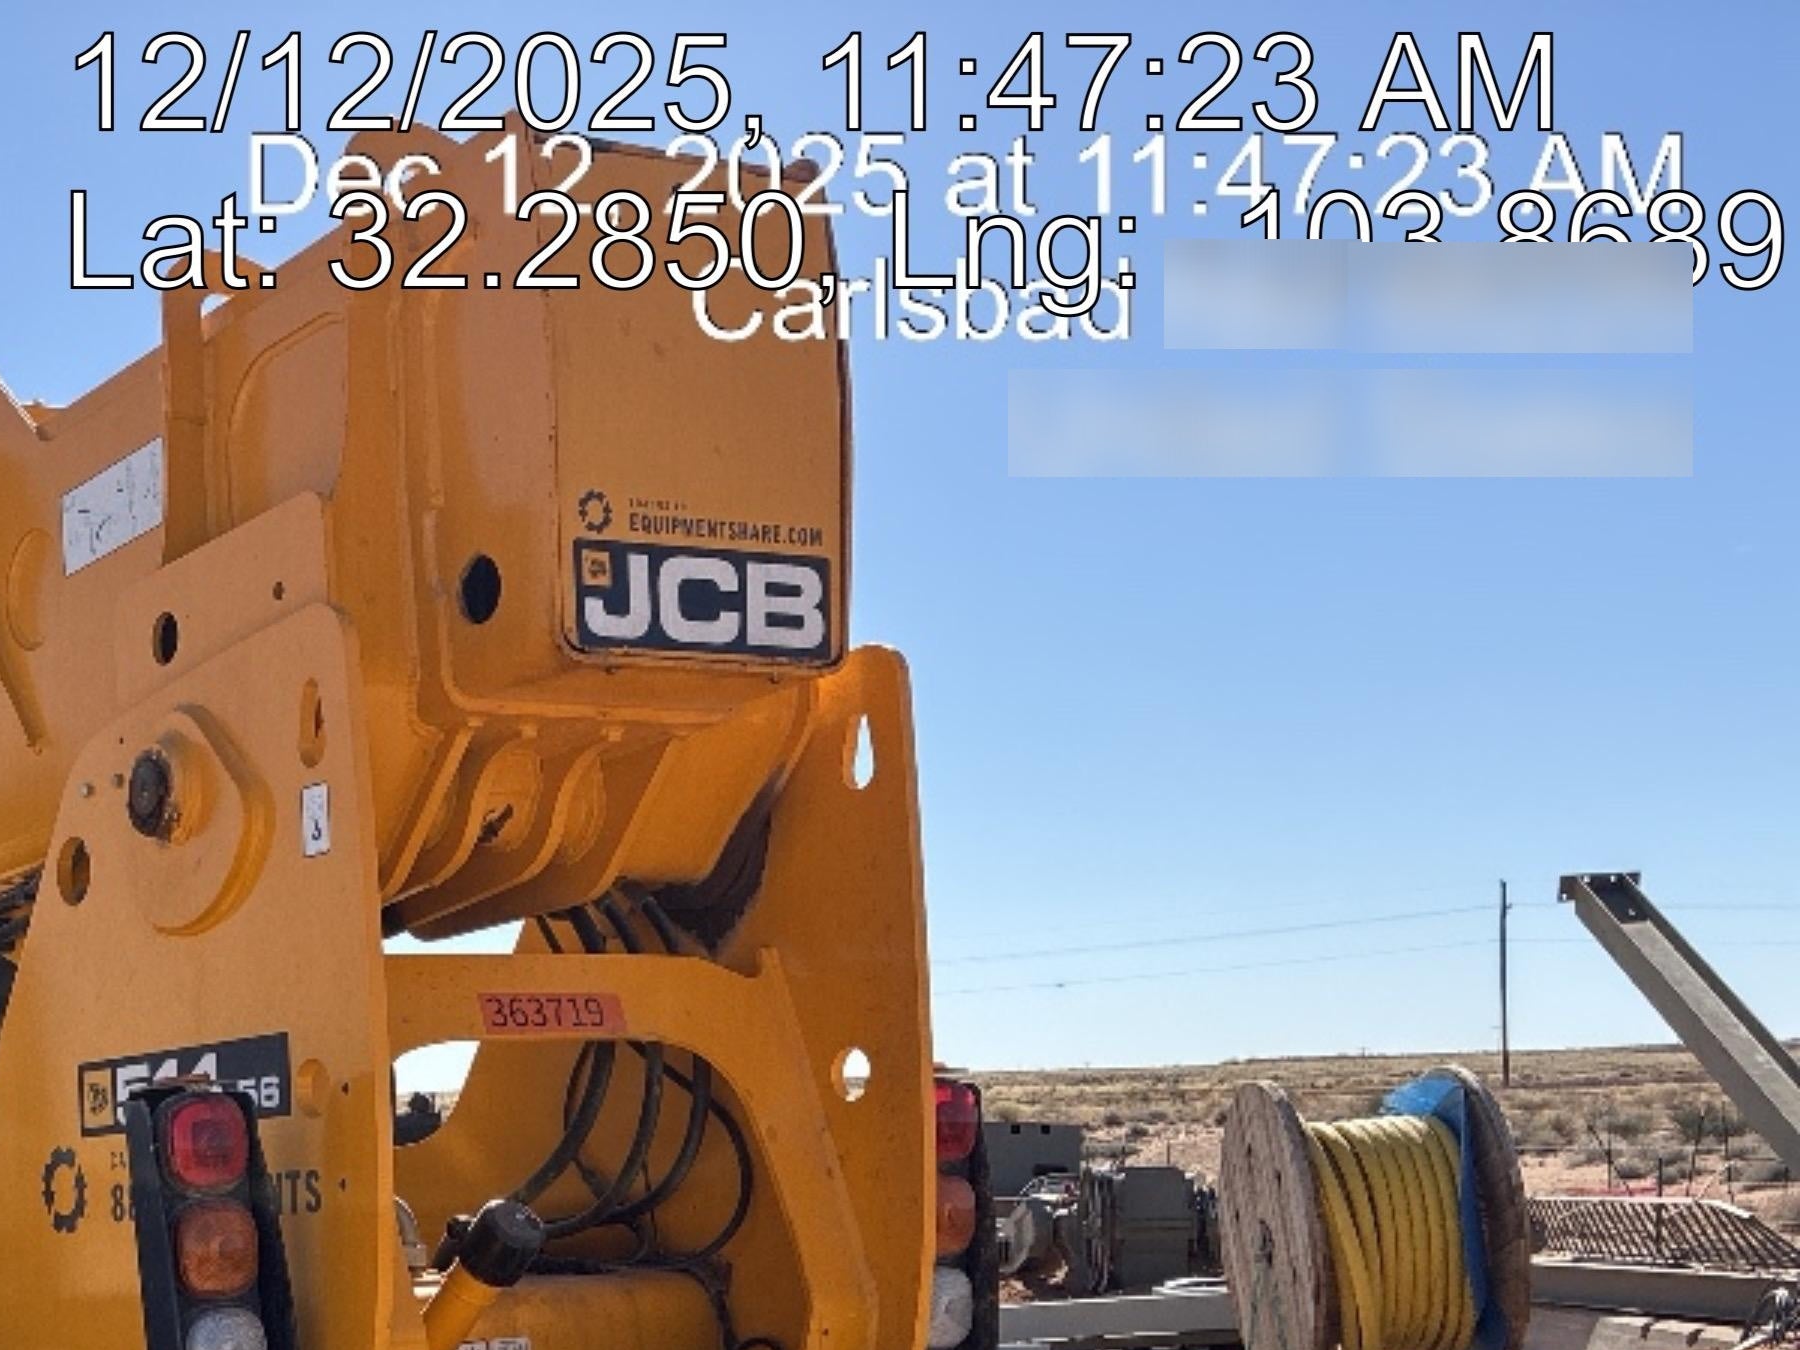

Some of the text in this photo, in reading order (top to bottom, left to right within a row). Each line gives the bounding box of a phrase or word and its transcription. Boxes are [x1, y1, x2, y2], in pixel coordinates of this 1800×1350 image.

[628, 512, 824, 547] EQUIPMENTSHARE.COM
[583, 553, 827, 650] JCB
[485, 997, 604, 1027] 363719
